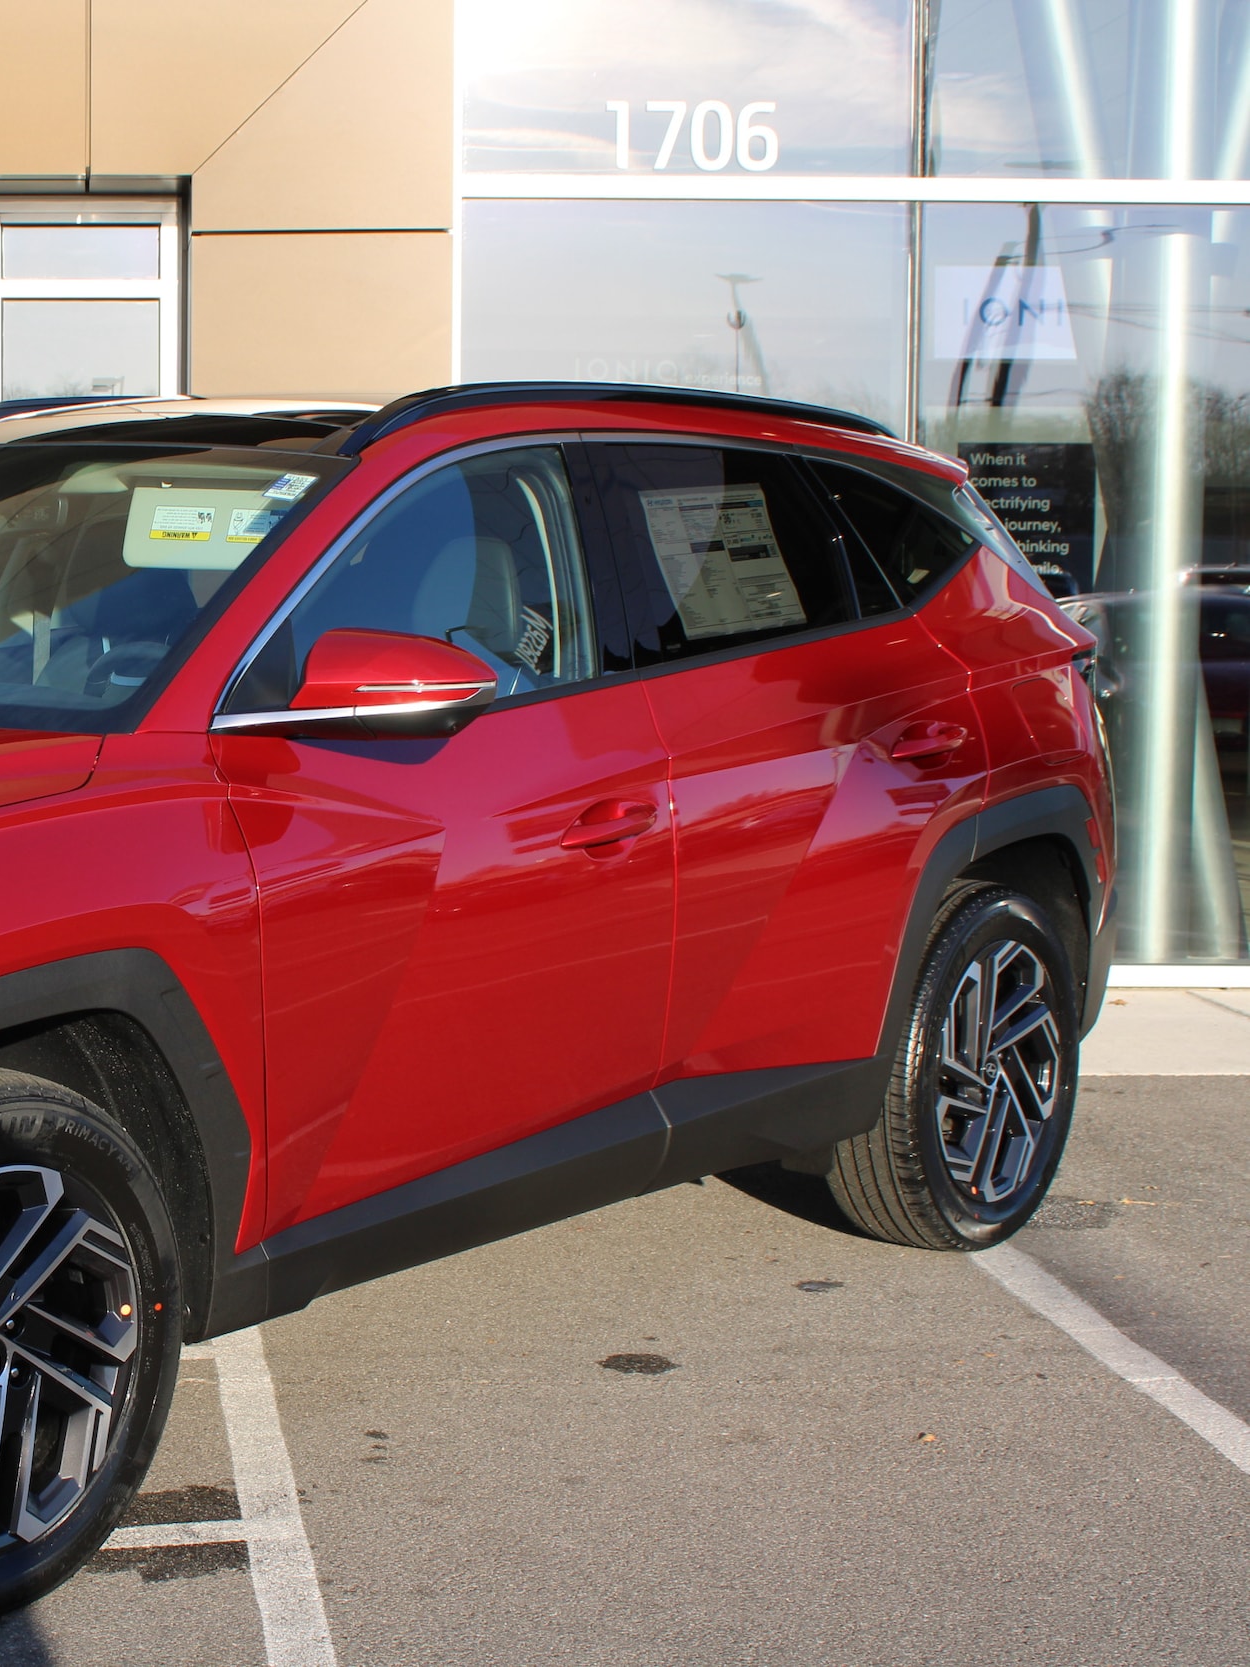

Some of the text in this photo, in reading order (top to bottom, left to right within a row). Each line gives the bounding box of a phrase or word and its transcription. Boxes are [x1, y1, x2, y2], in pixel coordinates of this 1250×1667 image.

[606, 100, 779, 172] 1706
[963, 297, 1063, 327] IONI
[574, 357, 763, 387] IONIQ experience
[969, 453, 1027, 466] When it
[970, 476, 1037, 488] comes to
[985, 496, 1051, 512] ectrifying
[1004, 518, 1062, 534] journey,
[161, 531, 191, 539] WARNING
[1016, 539, 1070, 556] hinking
